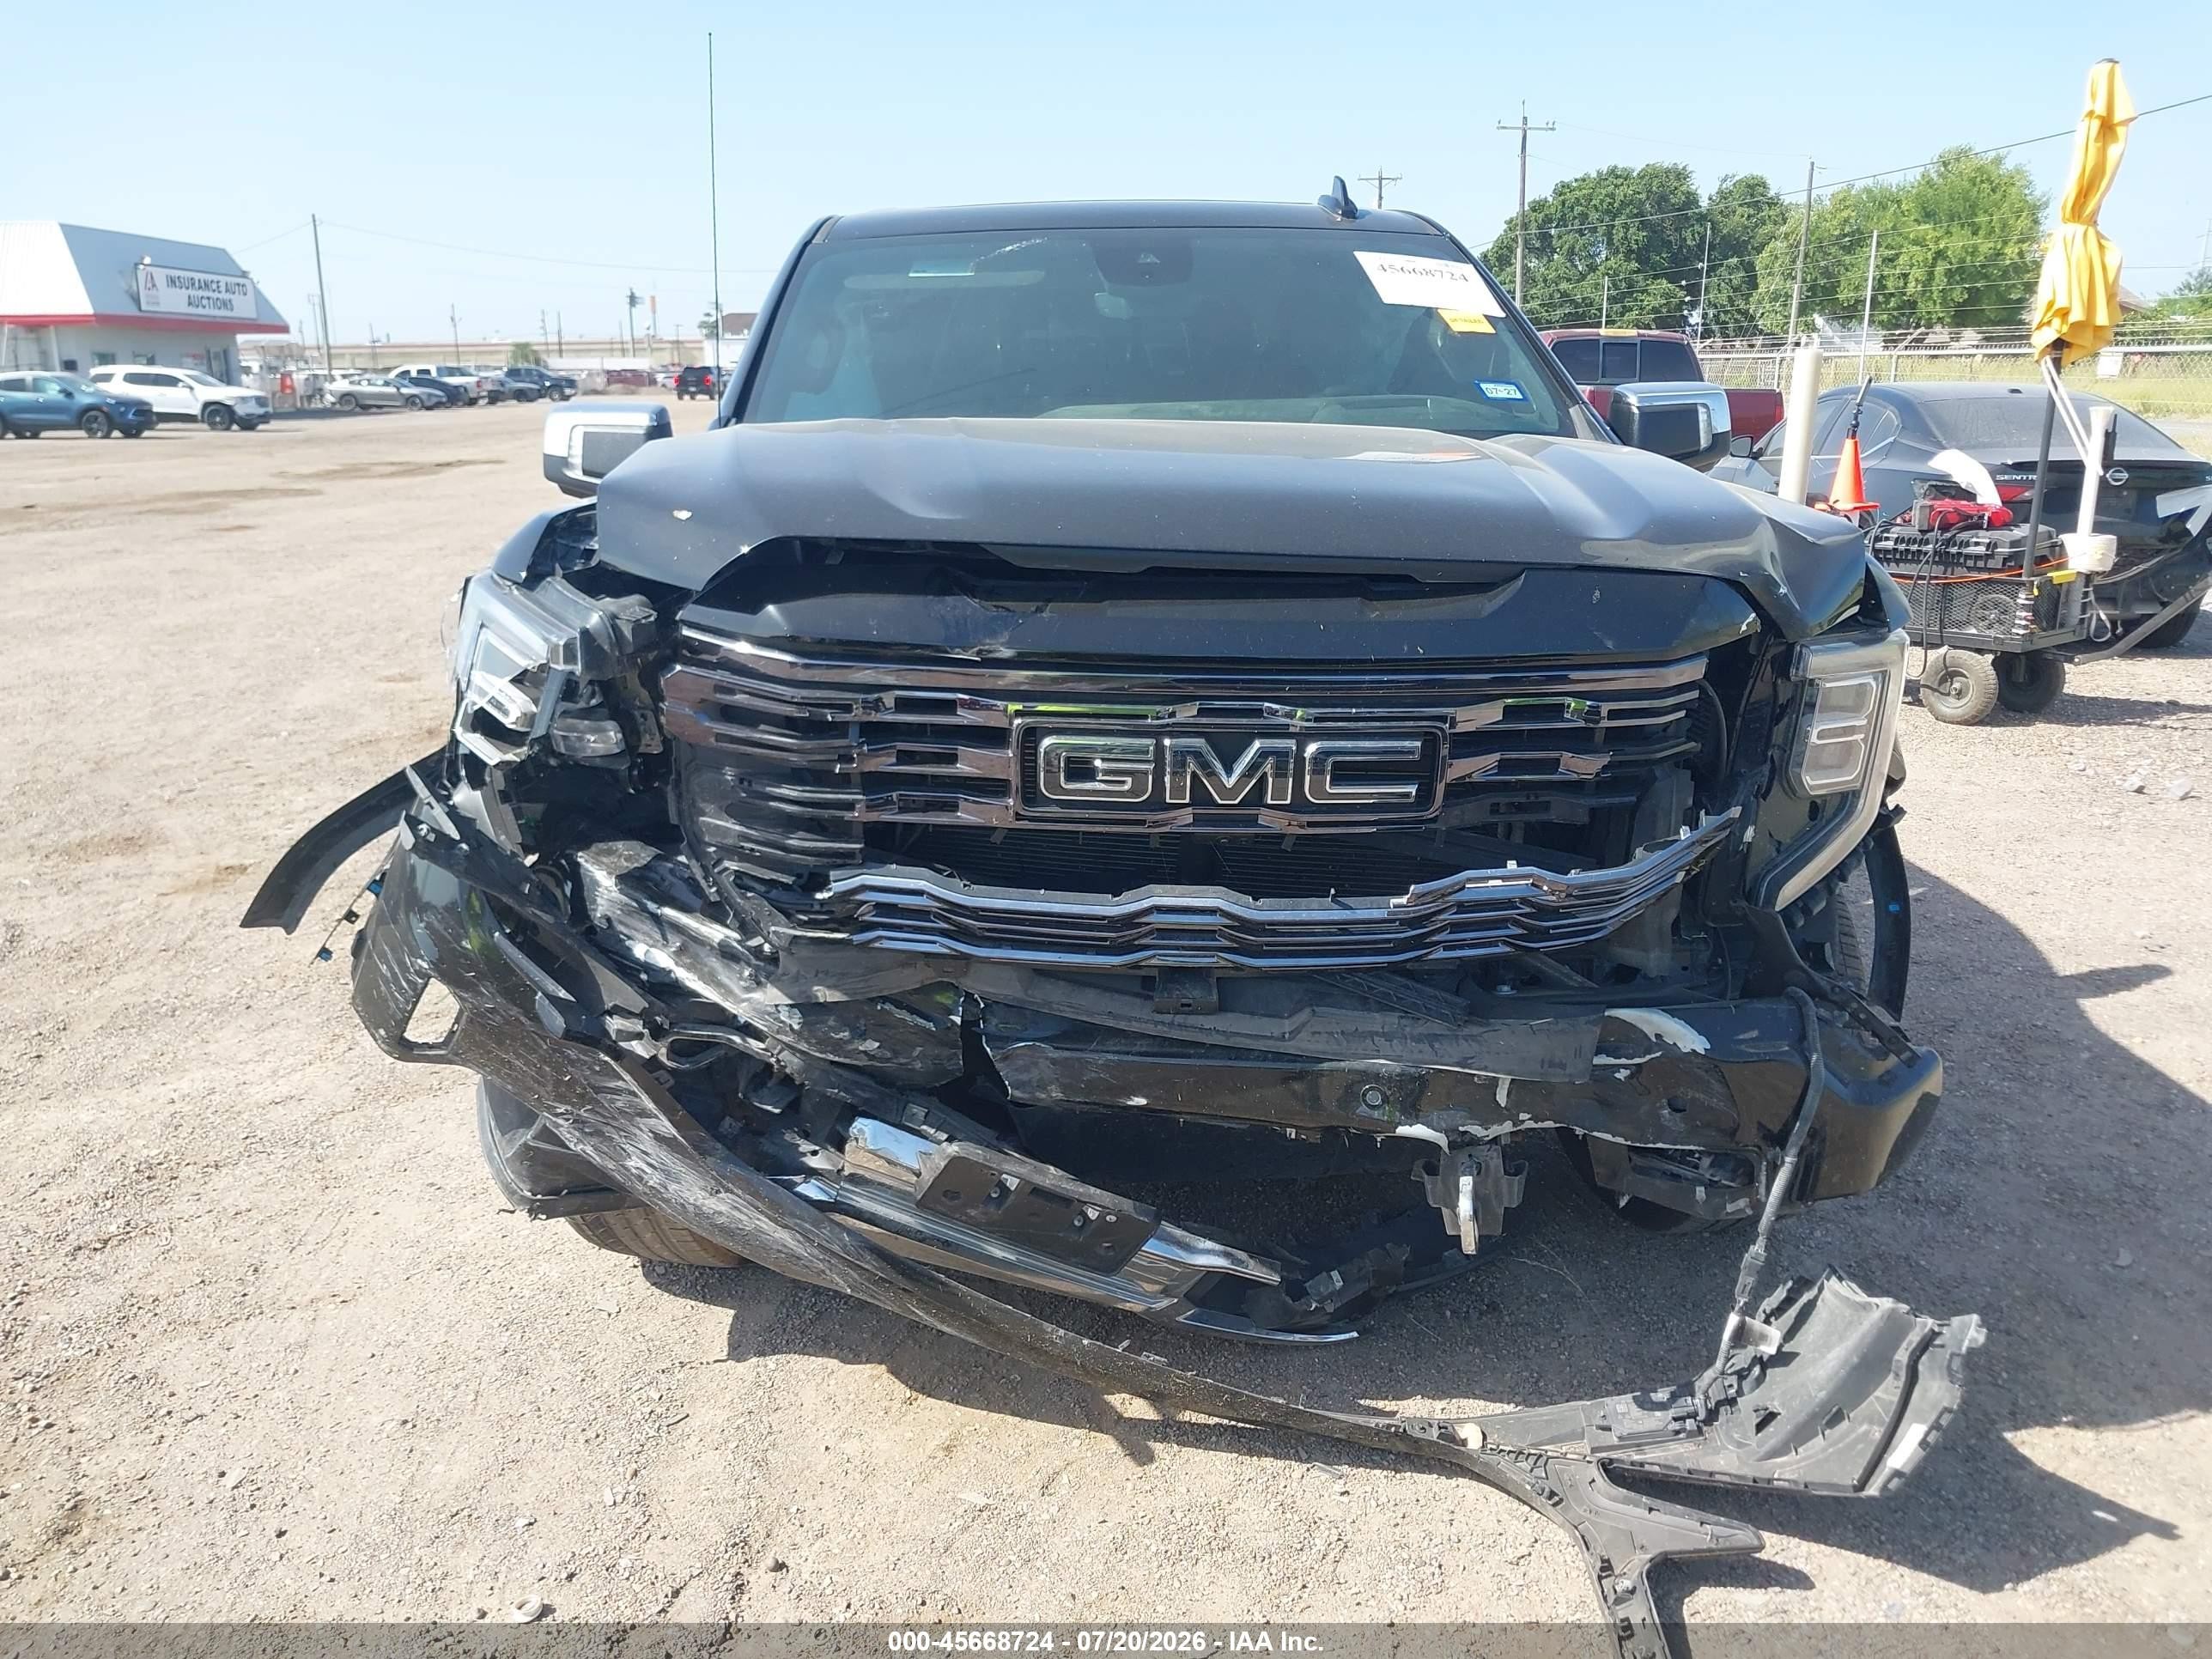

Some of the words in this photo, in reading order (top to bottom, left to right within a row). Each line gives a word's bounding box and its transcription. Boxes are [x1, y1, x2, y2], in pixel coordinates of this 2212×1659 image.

[1377, 264, 1469, 282] 45668724
[166, 274, 222, 294] INSURANCE
[224, 282, 248, 296] AUTO
[188, 294, 234, 312] AUCTIONS
[1037, 735, 1424, 805] GMC
